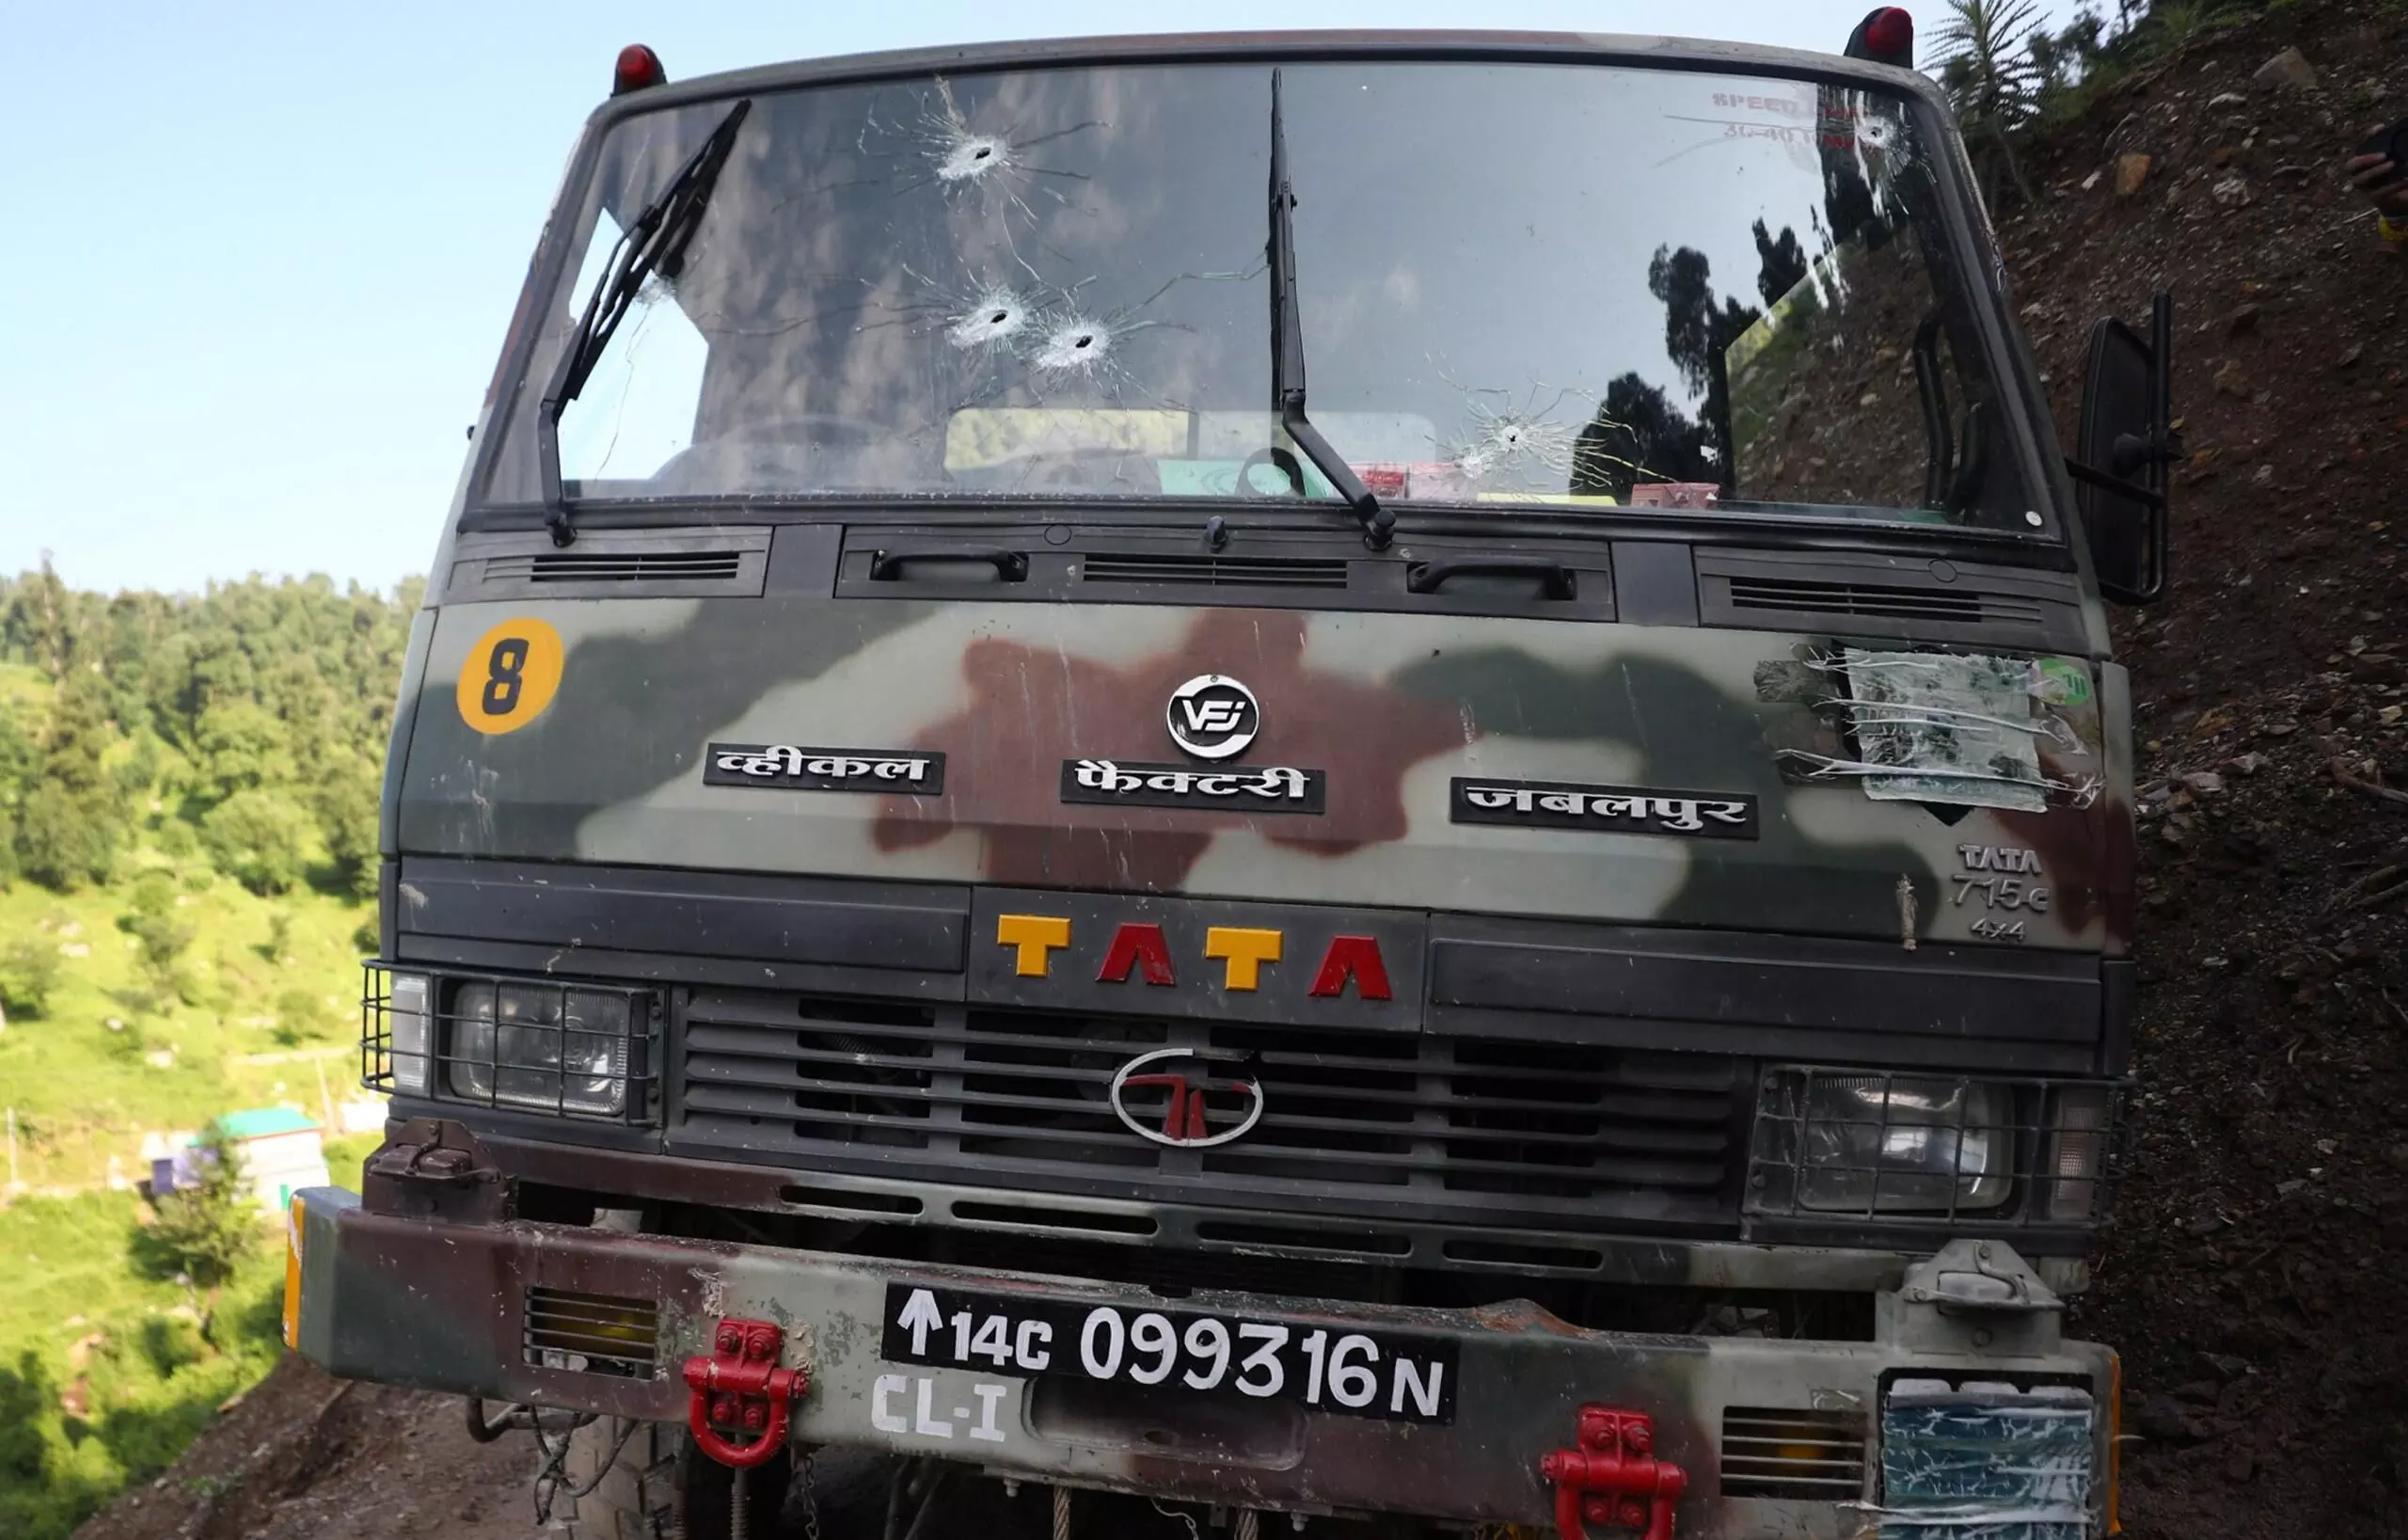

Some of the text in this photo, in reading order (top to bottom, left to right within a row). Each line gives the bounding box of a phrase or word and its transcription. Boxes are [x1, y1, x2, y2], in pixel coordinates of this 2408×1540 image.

[1712, 92, 1798, 114] SPEED
[482, 637, 530, 716] 8
[716, 745, 931, 781] व्हीकल
[1074, 759, 1311, 798] फैक्टरी
[1465, 786, 1747, 831] जबलपुर
[1958, 844, 2042, 874] TATA
[997, 913, 1393, 1001] TATA
[950, 1310, 1054, 1371] 14C
